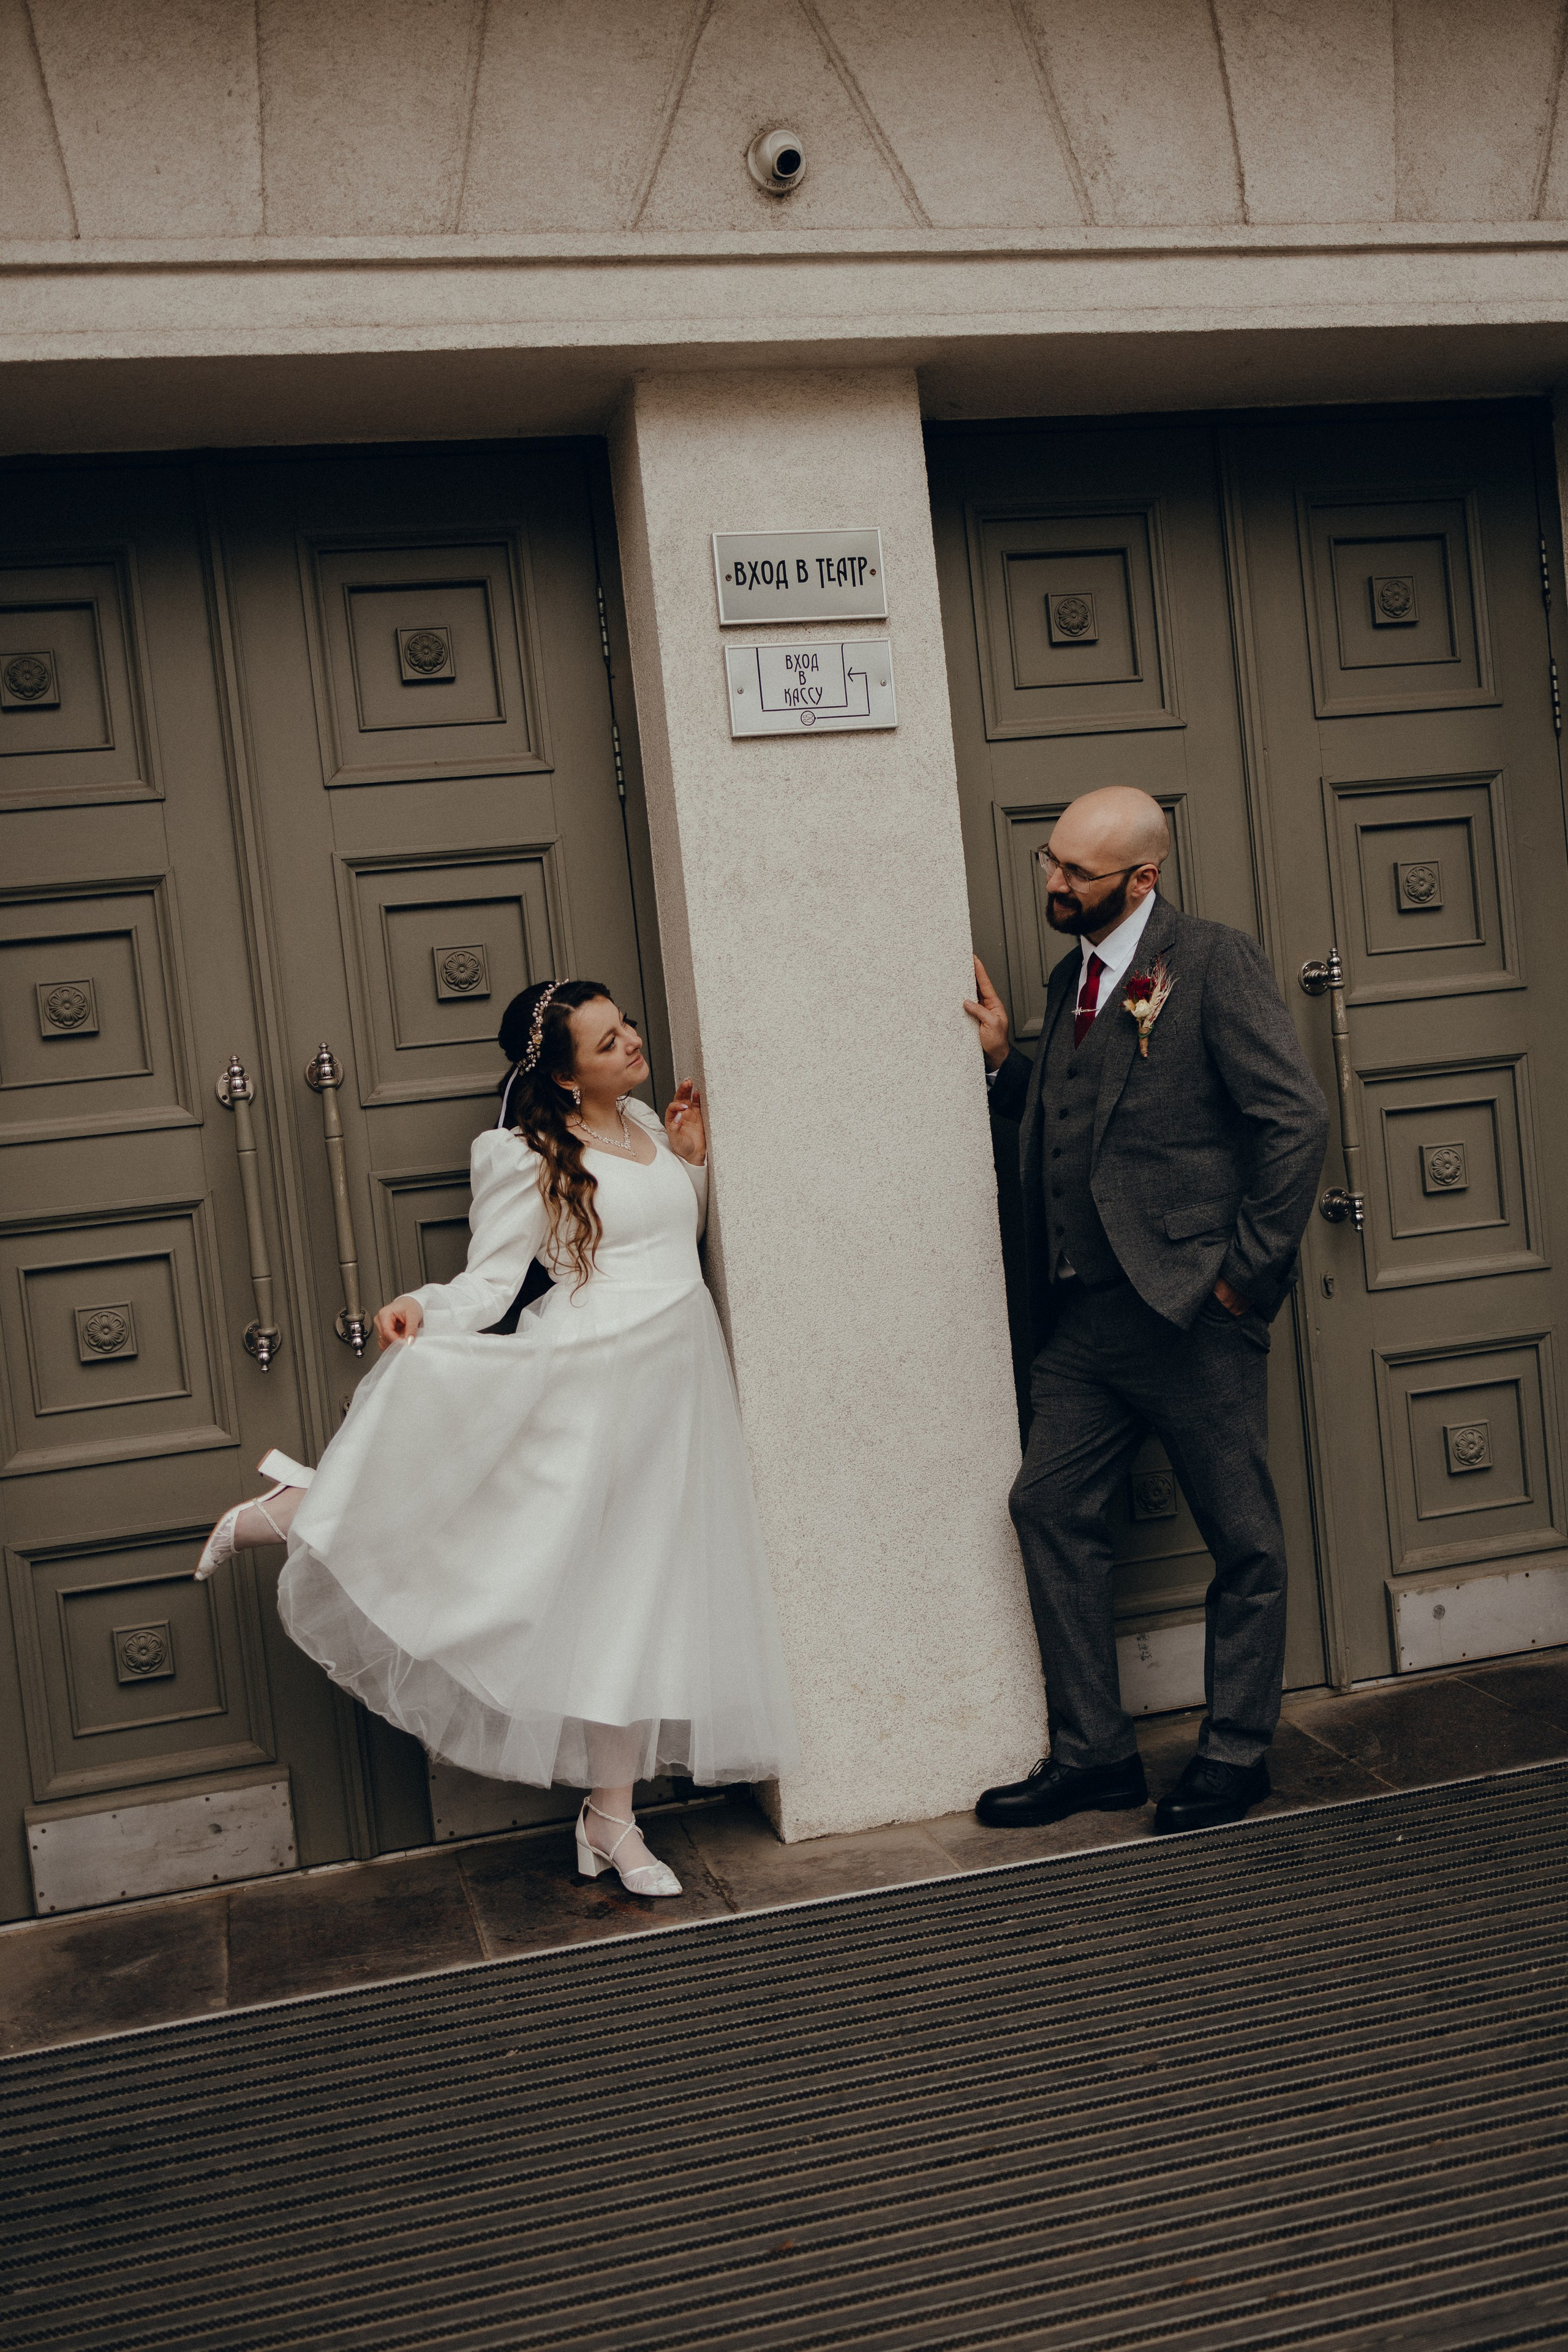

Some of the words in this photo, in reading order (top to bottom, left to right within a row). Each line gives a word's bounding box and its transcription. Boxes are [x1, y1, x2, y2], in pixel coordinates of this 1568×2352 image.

[734, 560, 789, 590] ВХОД
[796, 559, 809, 583] В
[815, 556, 868, 589] ТЕАТР
[785, 653, 820, 673] ВХОД
[798, 670, 807, 685] В
[784, 687, 823, 707] КАССУ
